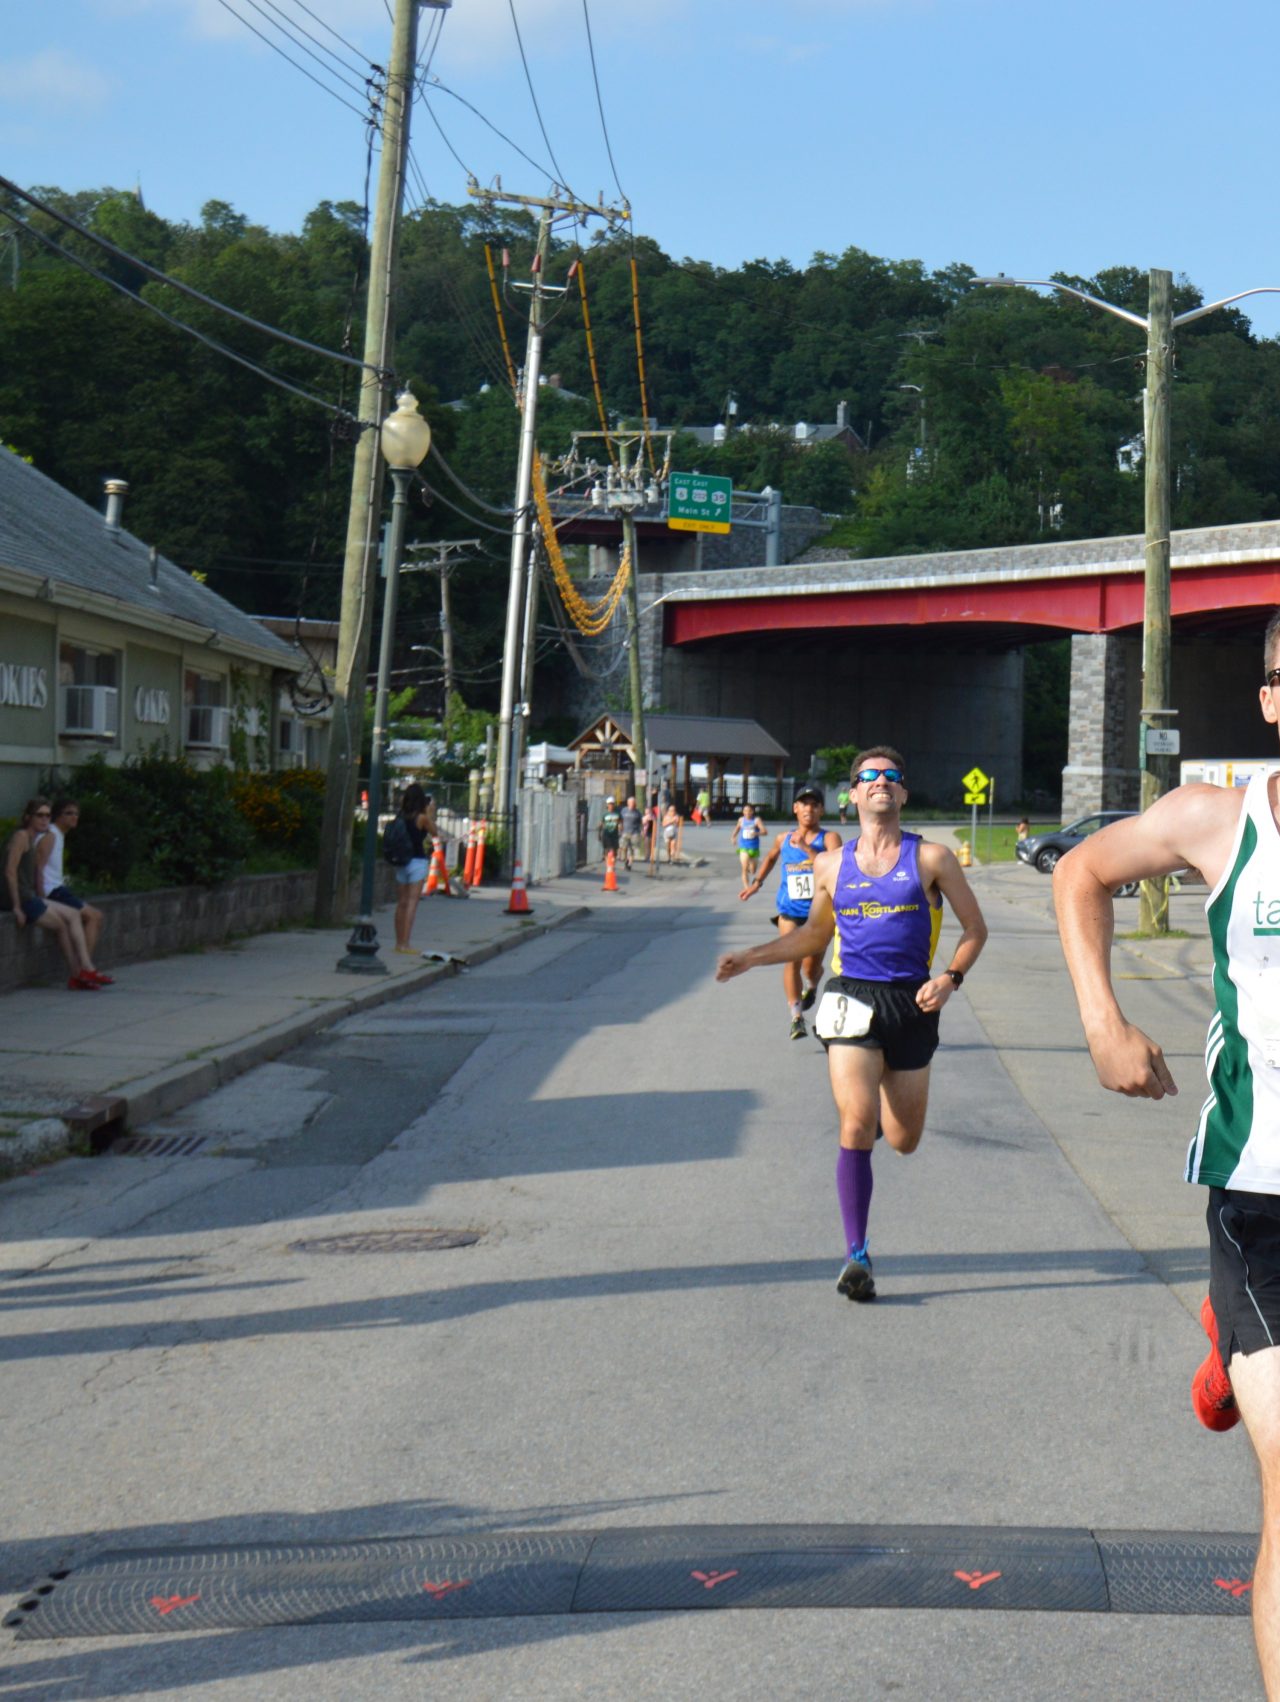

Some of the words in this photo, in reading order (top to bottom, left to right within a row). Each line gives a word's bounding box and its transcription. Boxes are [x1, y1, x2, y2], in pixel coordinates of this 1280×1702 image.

[678, 506, 698, 515] Main
[795, 876, 811, 898] 54
[840, 907, 859, 917] VAN
[833, 995, 848, 1035] 3
